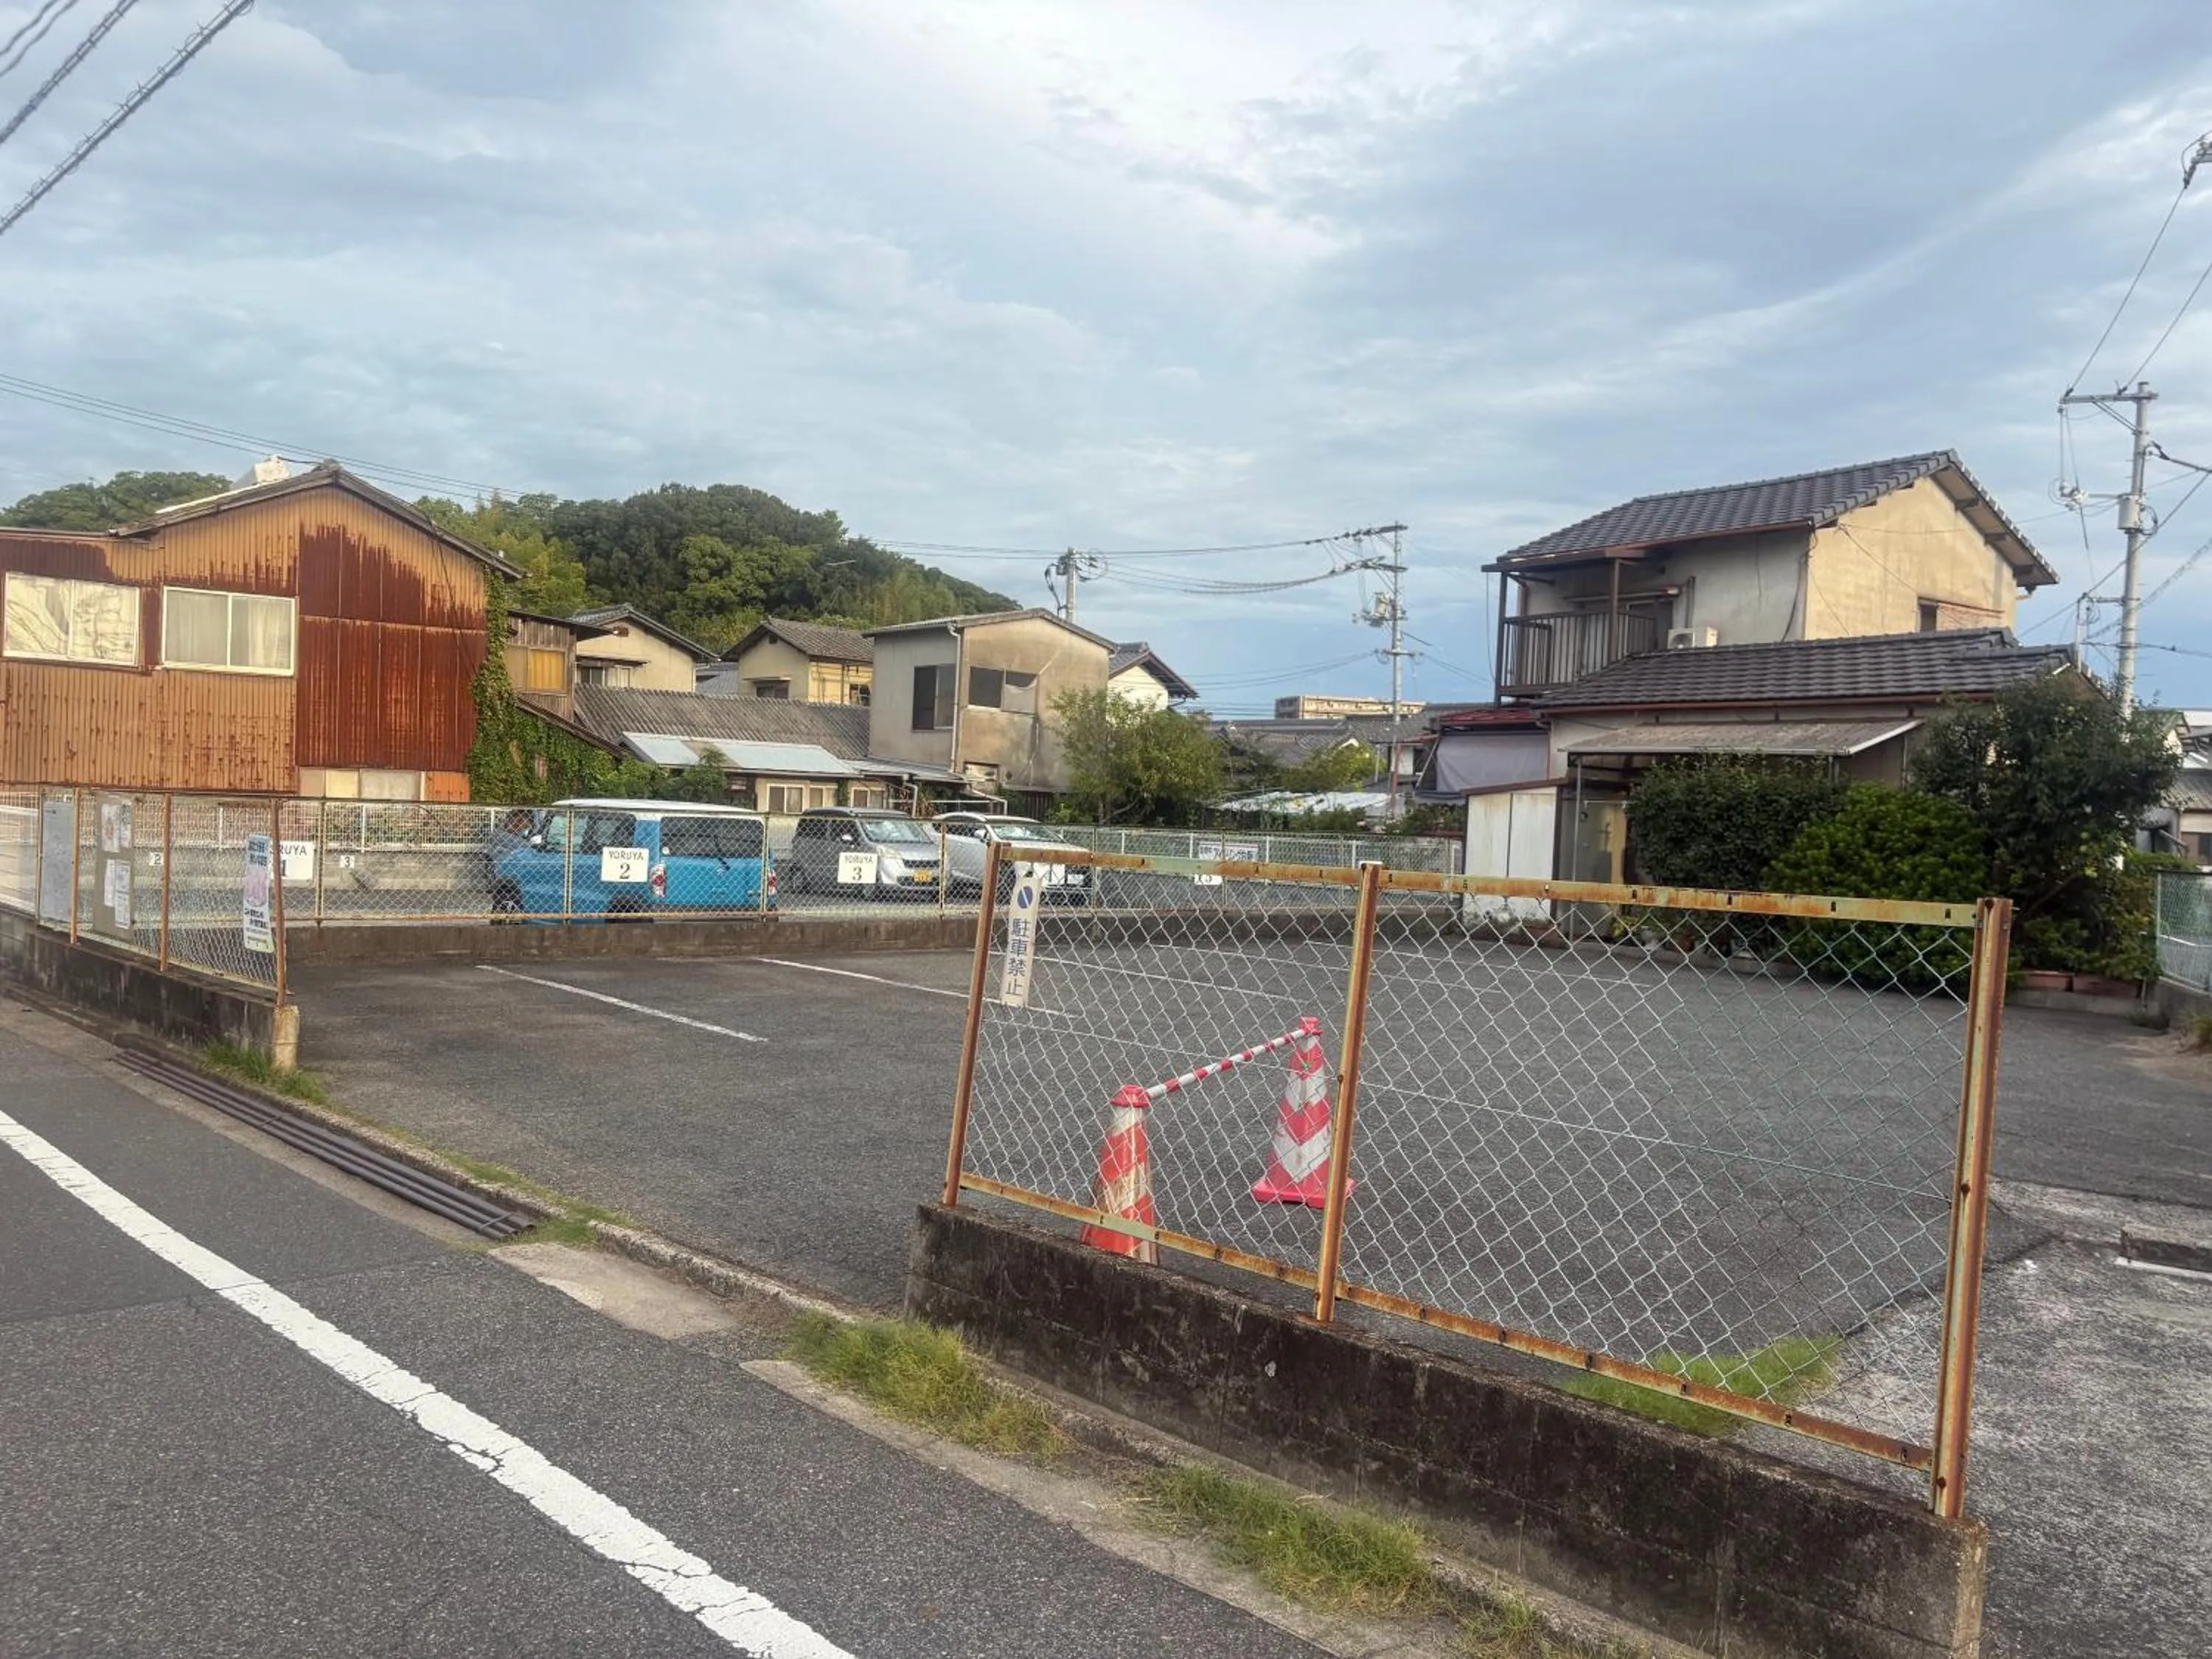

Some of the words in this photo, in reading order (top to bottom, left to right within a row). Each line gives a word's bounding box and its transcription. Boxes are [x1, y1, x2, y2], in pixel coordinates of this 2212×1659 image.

[154, 853, 161, 865] 2
[609, 850, 644, 860] YORUYA
[344, 856, 350, 868] 3
[619, 863, 630, 879] 2
[852, 866, 862, 880] 3
[1006, 918, 1032, 995] 駐車禁止
